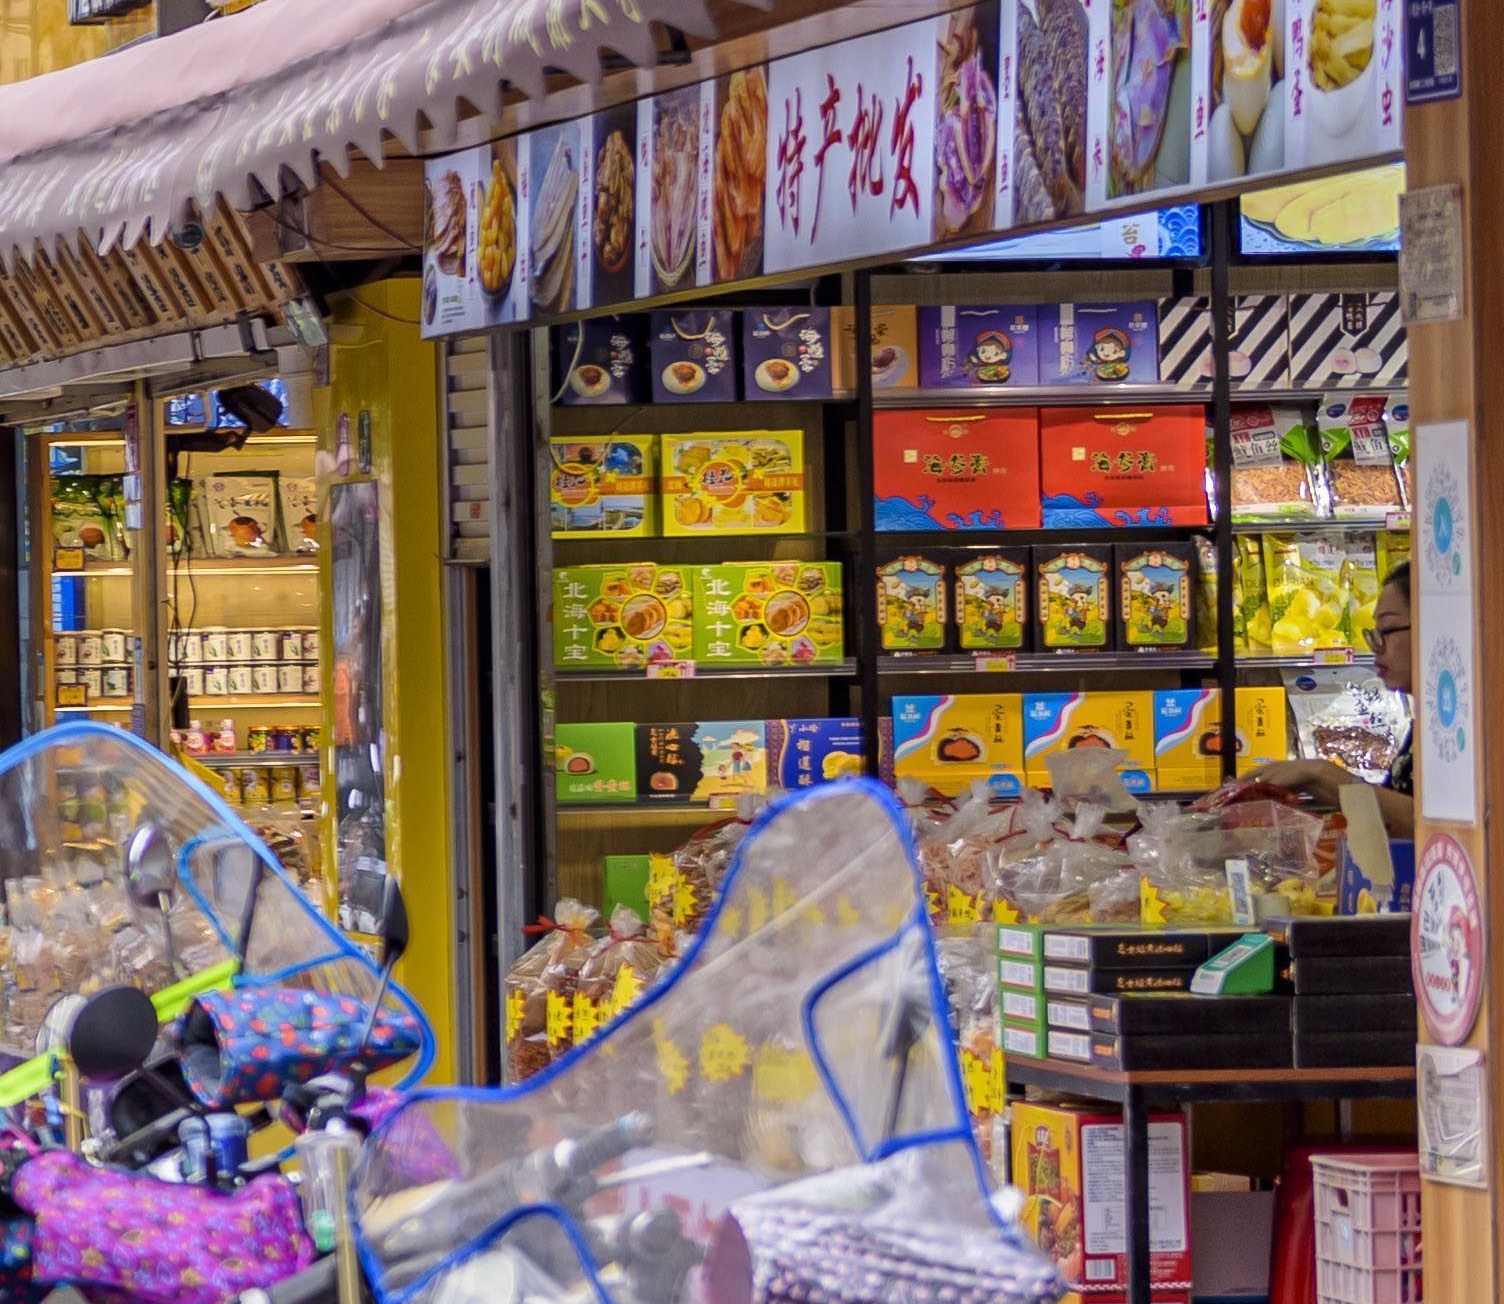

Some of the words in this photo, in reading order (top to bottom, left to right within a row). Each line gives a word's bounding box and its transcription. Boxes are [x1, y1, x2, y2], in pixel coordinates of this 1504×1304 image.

[776, 56, 923, 247] 特产批发
[562, 582, 589, 661] 北海十宝
[705, 578, 733, 657] 北海十宝
[1272, 576, 1314, 589] DURIAN
